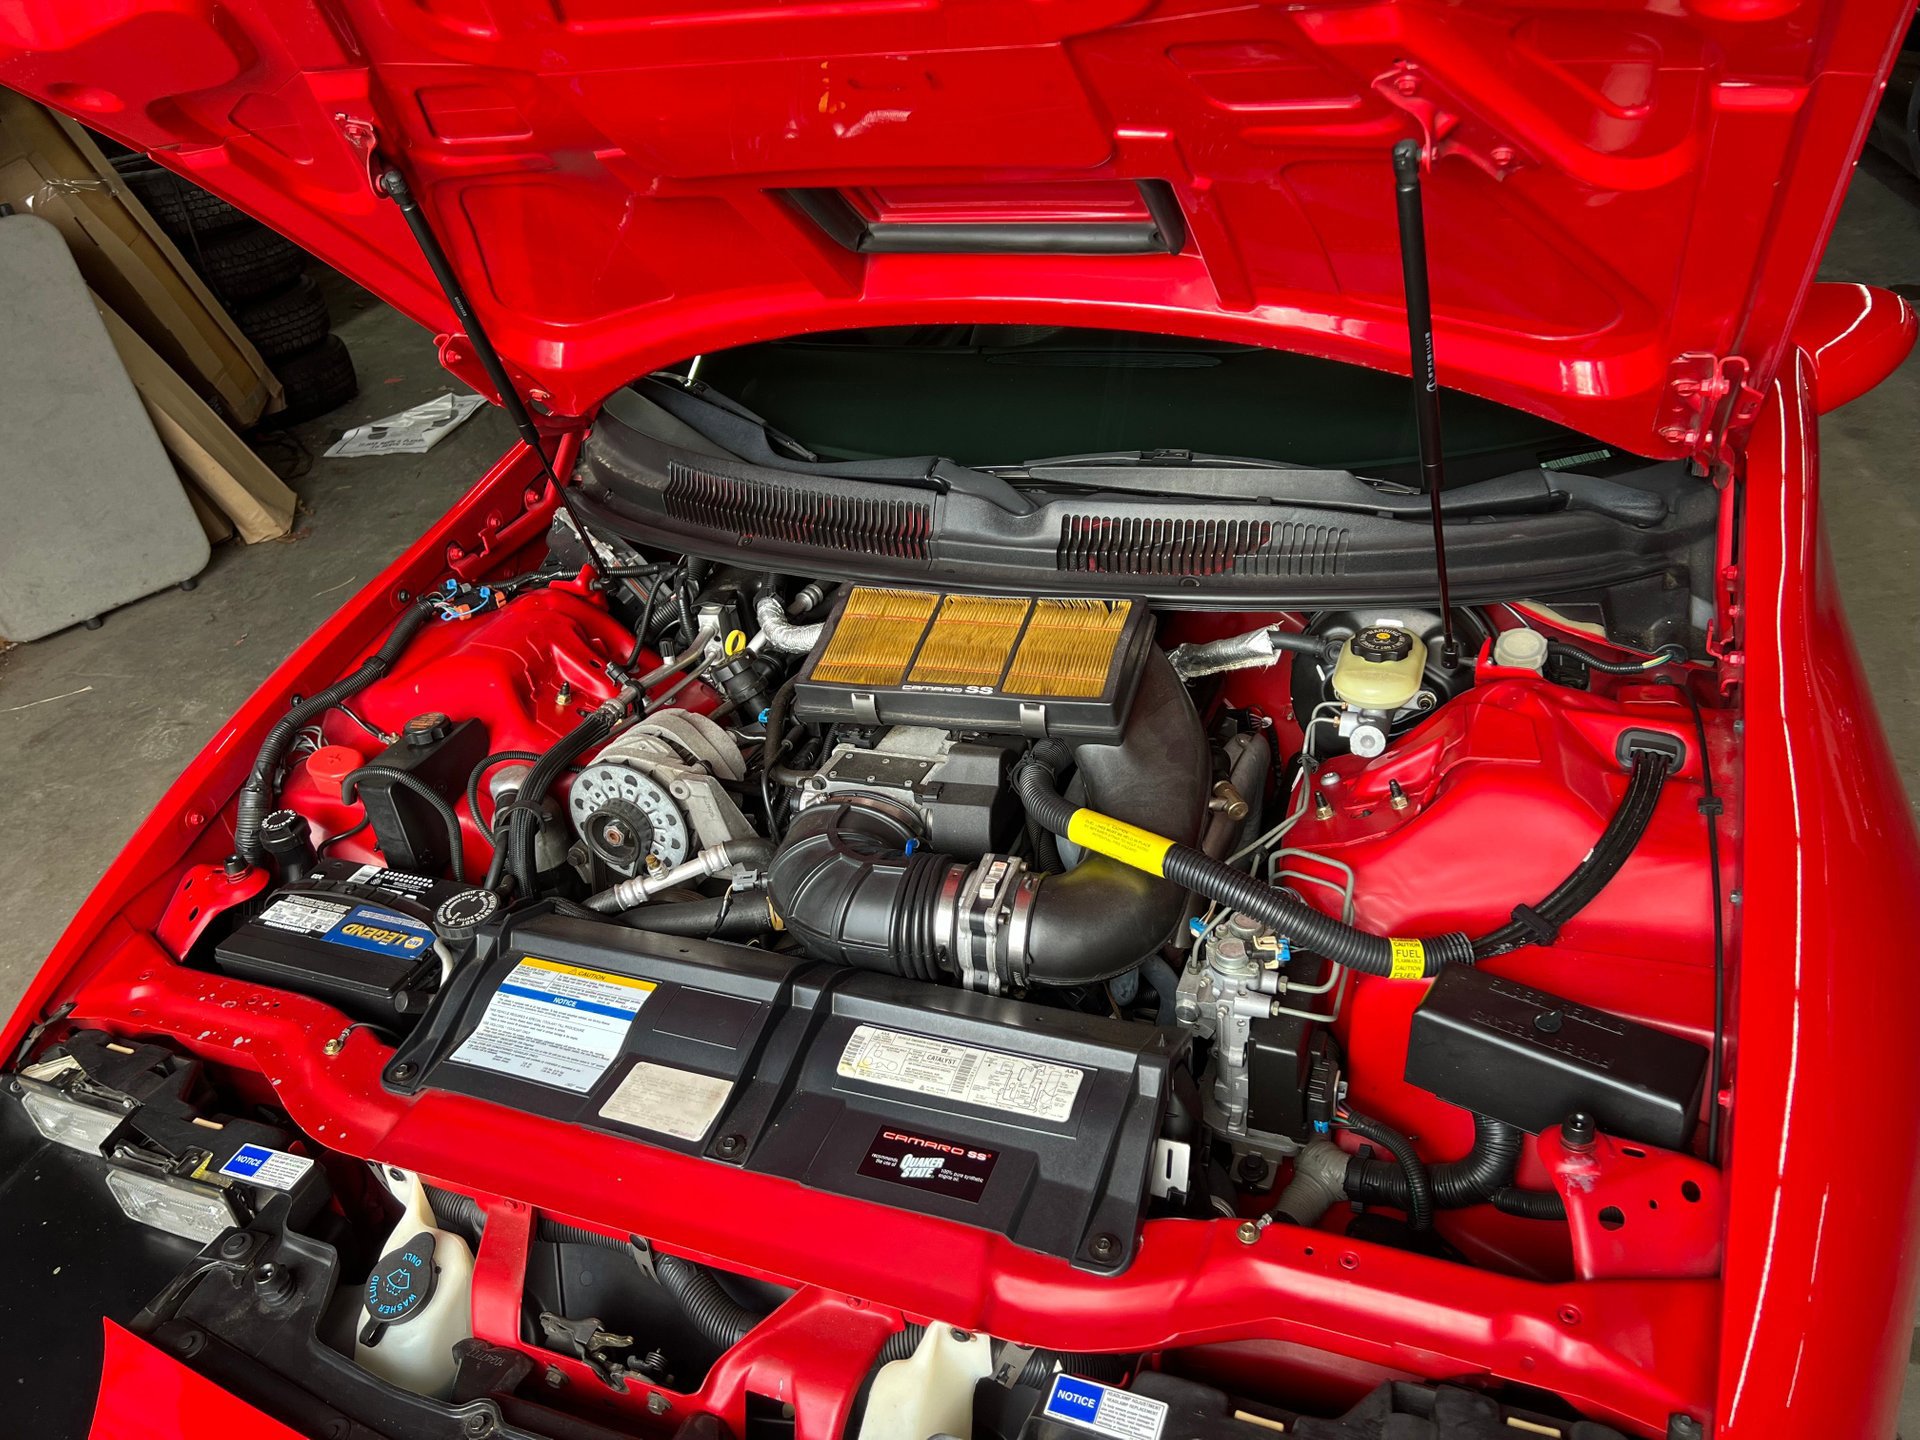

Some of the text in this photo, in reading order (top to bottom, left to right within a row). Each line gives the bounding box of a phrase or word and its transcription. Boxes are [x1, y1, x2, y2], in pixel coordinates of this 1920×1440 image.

[1425, 332, 1433, 379] STABILUS
[902, 684, 994, 695] CAMARO SS
[341, 923, 409, 946] LEGEND
[1396, 949, 1421, 958] FUEL
[578, 970, 606, 981] CAUTION
[553, 996, 577, 1008] NOTICE
[926, 1054, 957, 1065] CATALYST
[883, 1131, 987, 1161] CAMARO SS
[235, 1154, 262, 1167] NOTICE
[899, 1153, 945, 1170] QUAKER
[900, 1167, 935, 1179] STATE
[938, 1173, 952, 1181] engine
[941, 1168, 984, 1183] 100% pure synthetic
[402, 1252, 422, 1267] ONLY
[369, 1275, 380, 1304] FLUID
[378, 1293, 417, 1314] WASHER
[1057, 1389, 1096, 1409] NOTICE
[1106, 1397, 1159, 1416] HEADLAMP REPLACEMENT
[1107, 1391, 1161, 1410] HEADLAMP ADJUSTMENT
